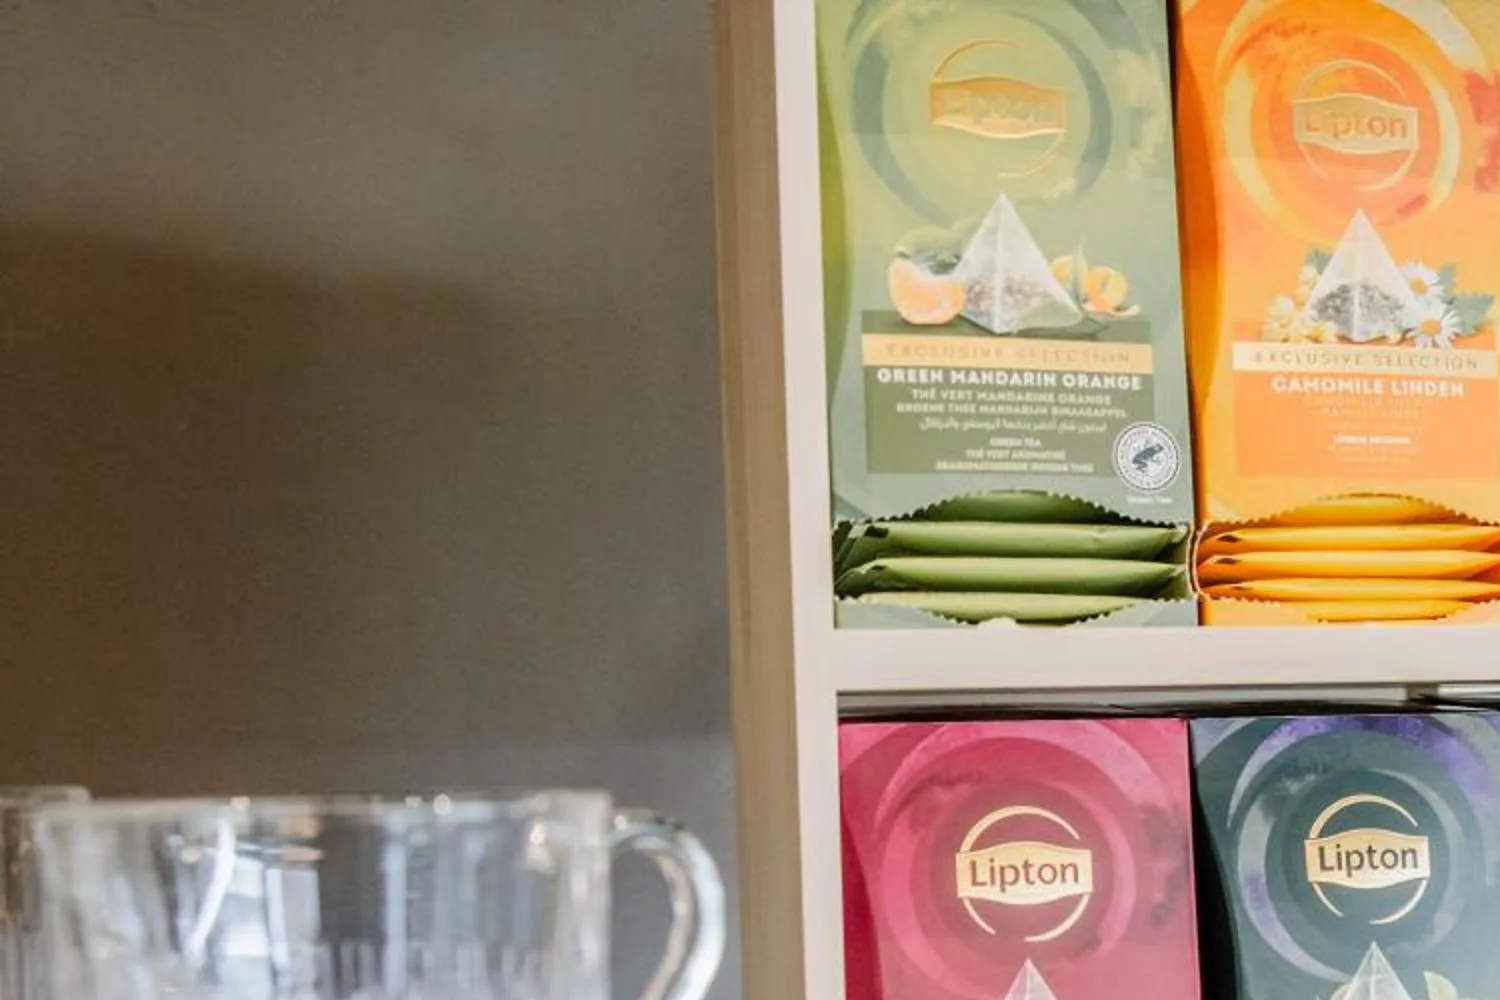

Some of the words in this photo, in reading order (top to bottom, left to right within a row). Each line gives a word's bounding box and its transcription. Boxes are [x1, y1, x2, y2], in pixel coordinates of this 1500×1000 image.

[1306, 108, 1408, 141] Lipton
[877, 368, 943, 384] GREEN
[950, 370, 1058, 388] MANDARIN
[1062, 374, 1143, 391] ORANGE
[1272, 375, 1384, 395] CAMOMILE
[1390, 379, 1466, 398] LINDEN
[969, 857, 1080, 893] Lipton
[1317, 843, 1418, 878] Lipton
